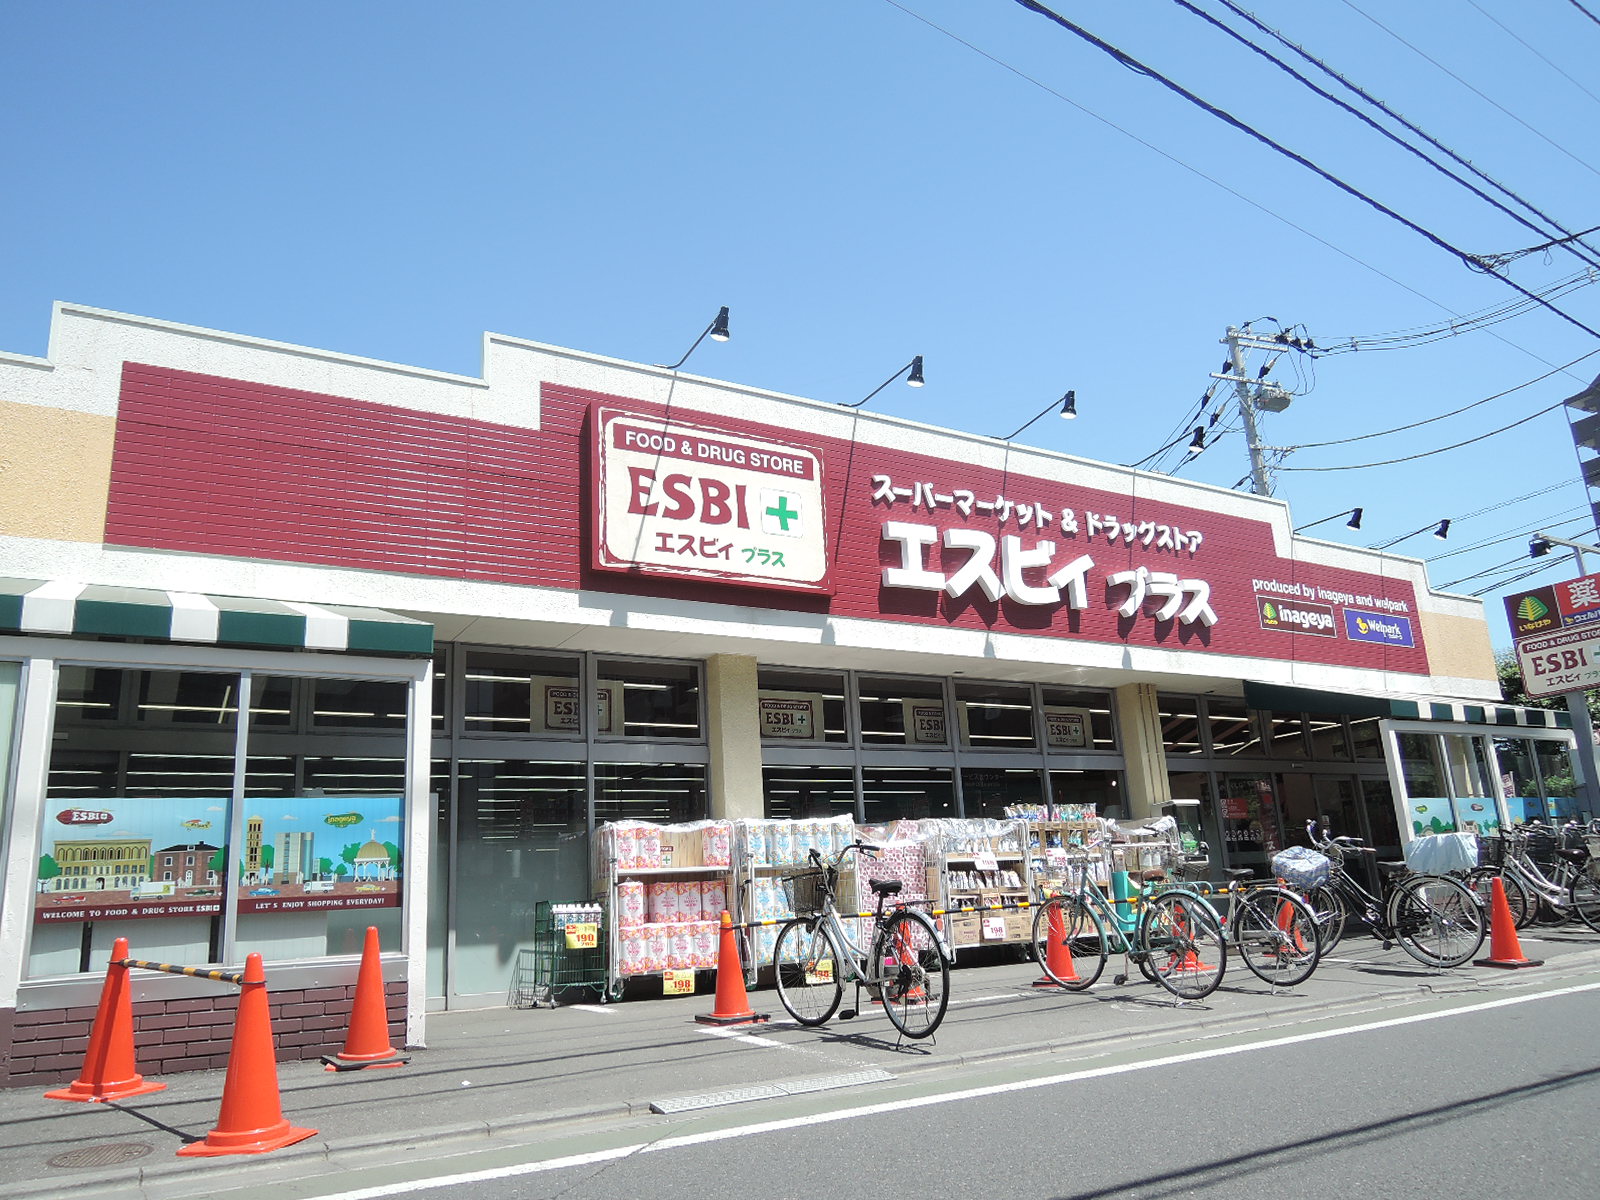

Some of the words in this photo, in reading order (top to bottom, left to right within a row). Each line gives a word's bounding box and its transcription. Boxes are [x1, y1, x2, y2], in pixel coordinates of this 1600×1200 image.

[625, 431, 676, 452] FOOD
[680, 441, 693, 456] &
[697, 443, 746, 465] DRUG
[749, 452, 804, 475] STORE
[627, 466, 750, 530] ESBI
[870, 474, 1053, 528] スーパーマーケット
[1060, 508, 1079, 534] &
[1085, 511, 1203, 553] ドラッグストア
[741, 547, 786, 568] プラス
[1106, 565, 1220, 628] プラス
[1252, 578, 1301, 596] produced
[1302, 583, 1315, 600] by
[1317, 586, 1354, 606] inageya
[1355, 595, 1374, 607] and
[1375, 597, 1409, 613] welpark
[1567, 578, 1600, 609] 薬
[1278, 604, 1334, 630] inageya
[1526, 641, 1548, 651] FOOD
[1557, 632, 1581, 645] DRUG
[1531, 647, 1588, 676] ESBI
[766, 711, 794, 726] ESBI
[72, 811, 100, 822] ESBI
[42, 910, 85, 919] WELCOME
[89, 909, 101, 917] TO
[105, 908, 128, 916] FOOD
[142, 906, 165, 915] DRUG
[168, 905, 194, 913] STORE
[307, 899, 343, 907] SHOPPING
[346, 897, 385, 906] EVERYDAY!
[576, 933, 595, 942] 190
[673, 979, 691, 989] 198
